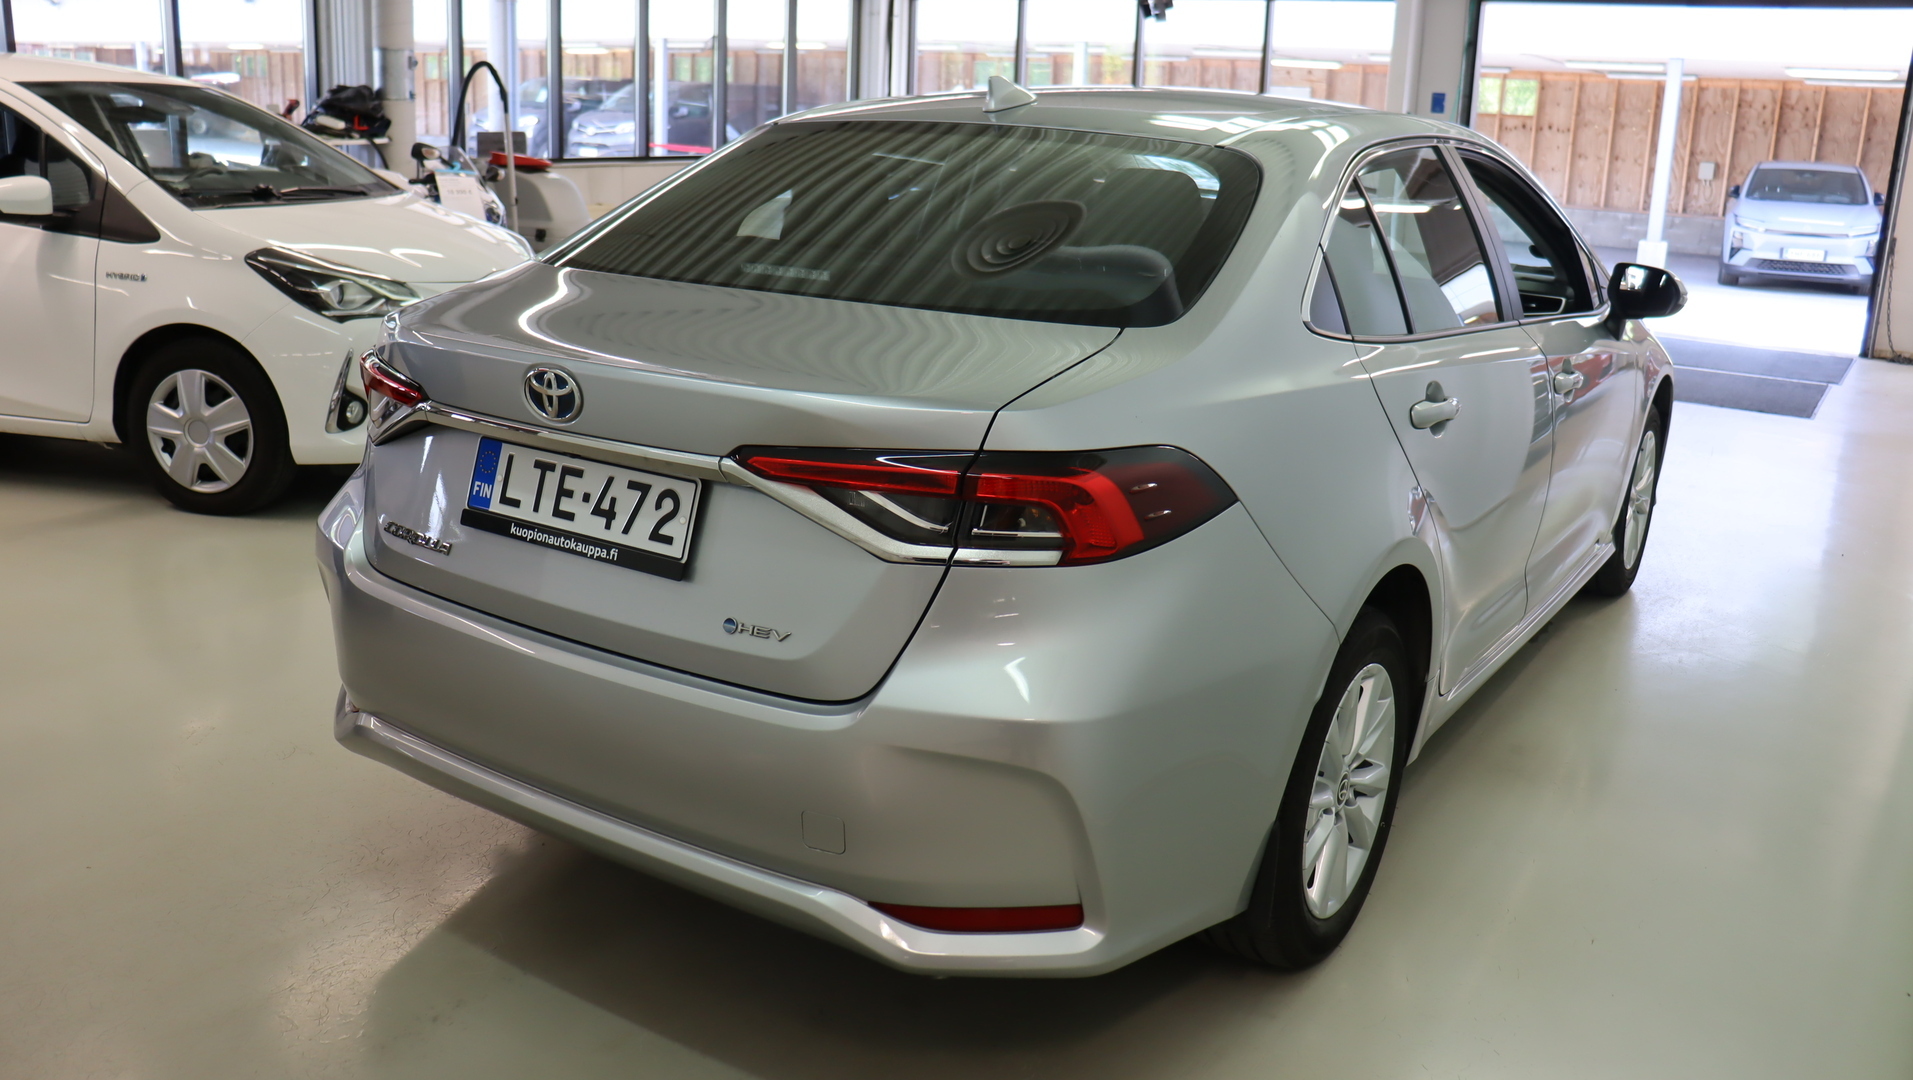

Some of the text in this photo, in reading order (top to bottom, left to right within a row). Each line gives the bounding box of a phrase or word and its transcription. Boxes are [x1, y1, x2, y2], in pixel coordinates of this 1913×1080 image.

[473, 480, 492, 499] FIN
[510, 522, 619, 562] kuopionautokauppa.fi
[738, 621, 792, 643] HEV
